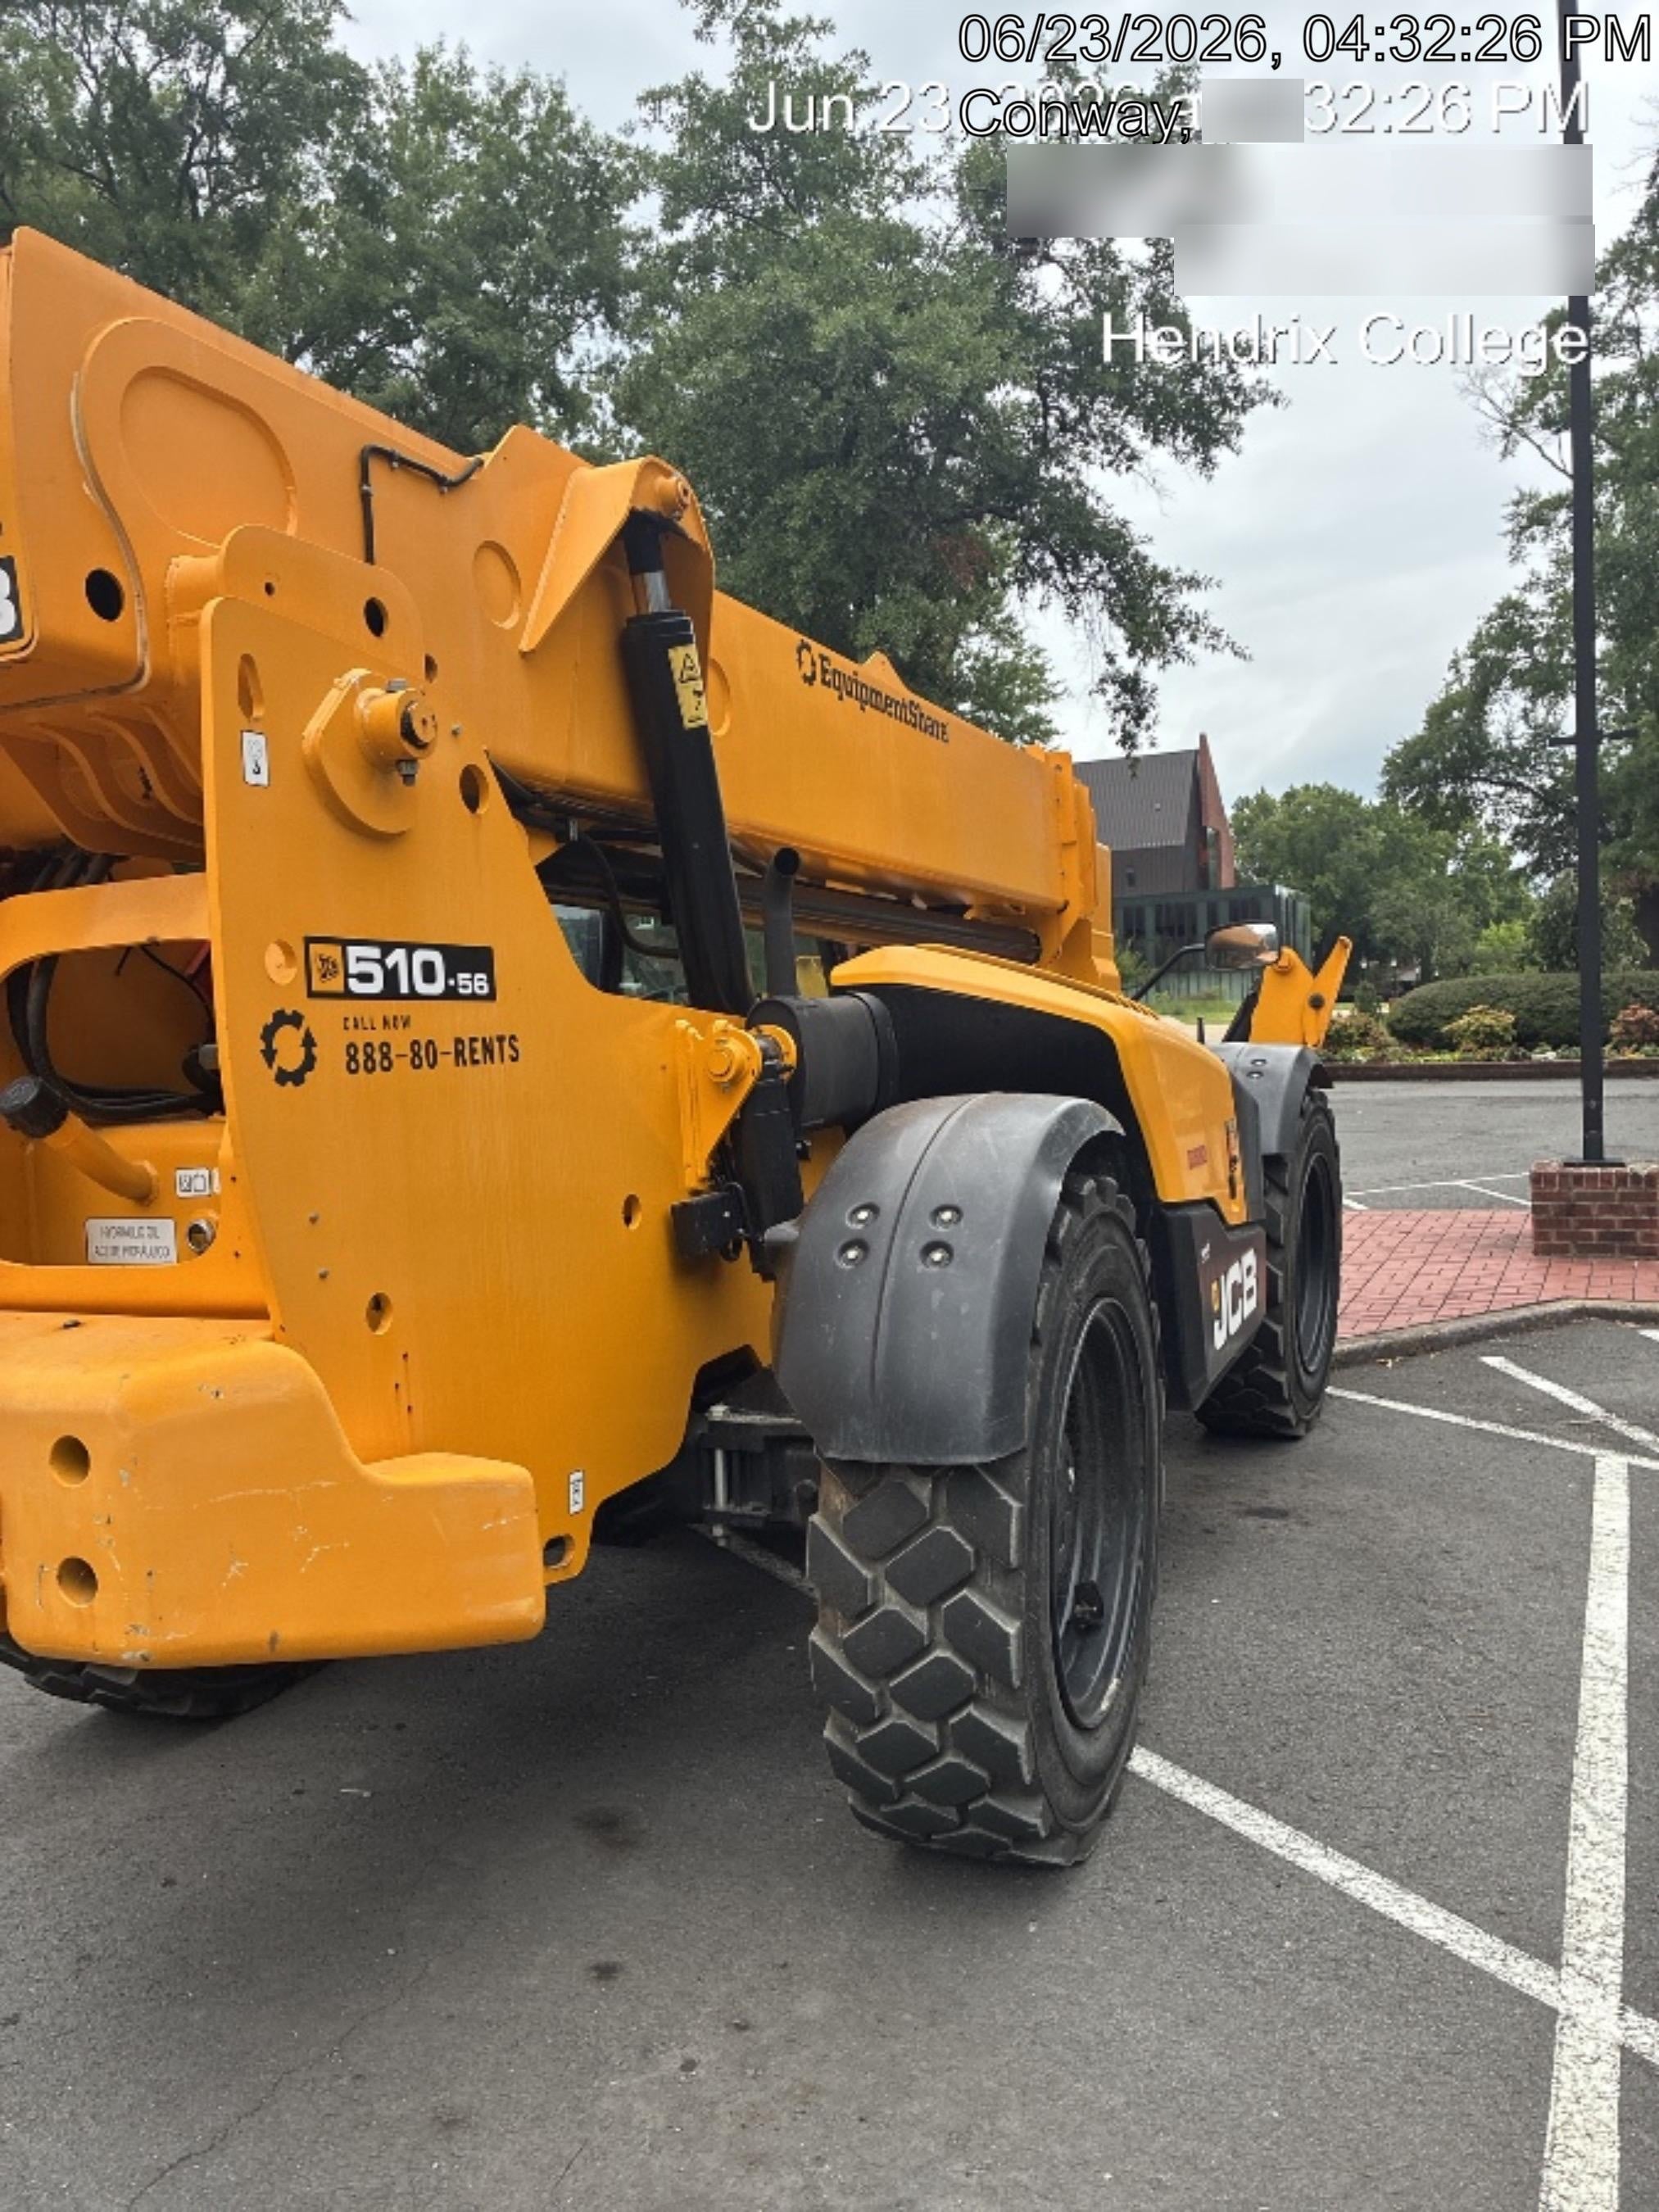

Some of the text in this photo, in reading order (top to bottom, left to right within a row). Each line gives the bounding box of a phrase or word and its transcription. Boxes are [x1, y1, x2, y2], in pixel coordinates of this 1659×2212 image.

[818, 653, 950, 742] EquipmentShare
[342, 1013, 411, 1031] CALL NOW
[345, 1034, 520, 1075] 888-80-RENTS
[1213, 1248, 1258, 1351] JCB
